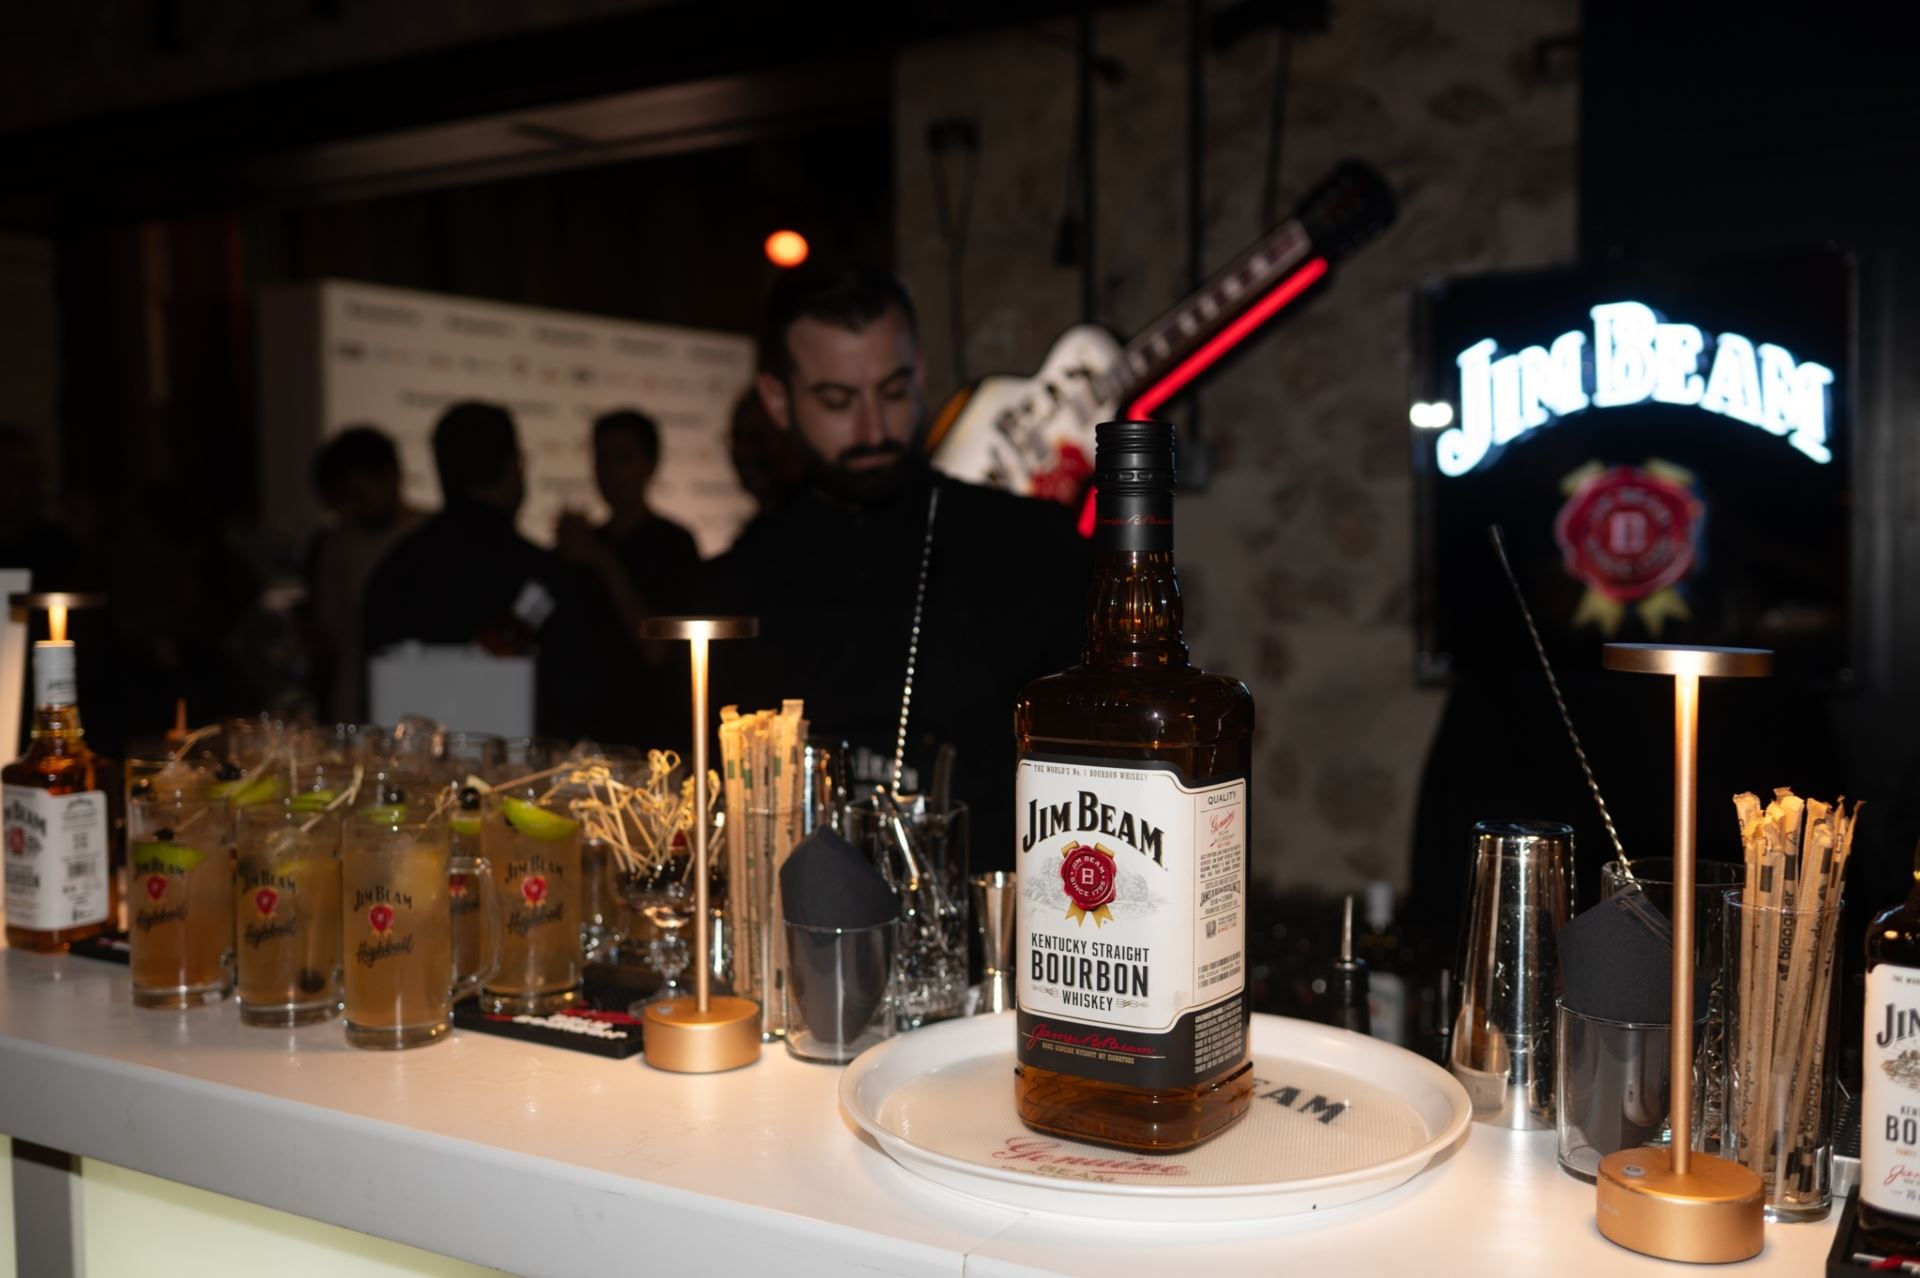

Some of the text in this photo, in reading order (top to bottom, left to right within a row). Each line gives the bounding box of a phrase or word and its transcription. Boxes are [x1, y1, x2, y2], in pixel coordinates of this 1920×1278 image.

[1437, 301, 1834, 477] JIM BEAM
[1034, 764, 1044, 773] THE
[1089, 770, 1117, 779] BOURBON
[1120, 772, 1148, 781] WHISKEY
[1208, 791, 1236, 805] QUALITY
[1023, 799, 1071, 853] JIM
[1077, 790, 1164, 868] BEAM
[1072, 856, 1105, 874] JIM BEAM
[1070, 877, 1089, 896] SINCE
[1082, 868, 1094, 885] B
[1031, 932, 1150, 963] KENTUCKY STRAIGHT
[1031, 950, 1149, 997] BOURBON
[1062, 989, 1113, 1011] WHISKEY
[1075, 1048, 1096, 1059] WITHOUT
[993, 1137, 1188, 1176] Genuine
